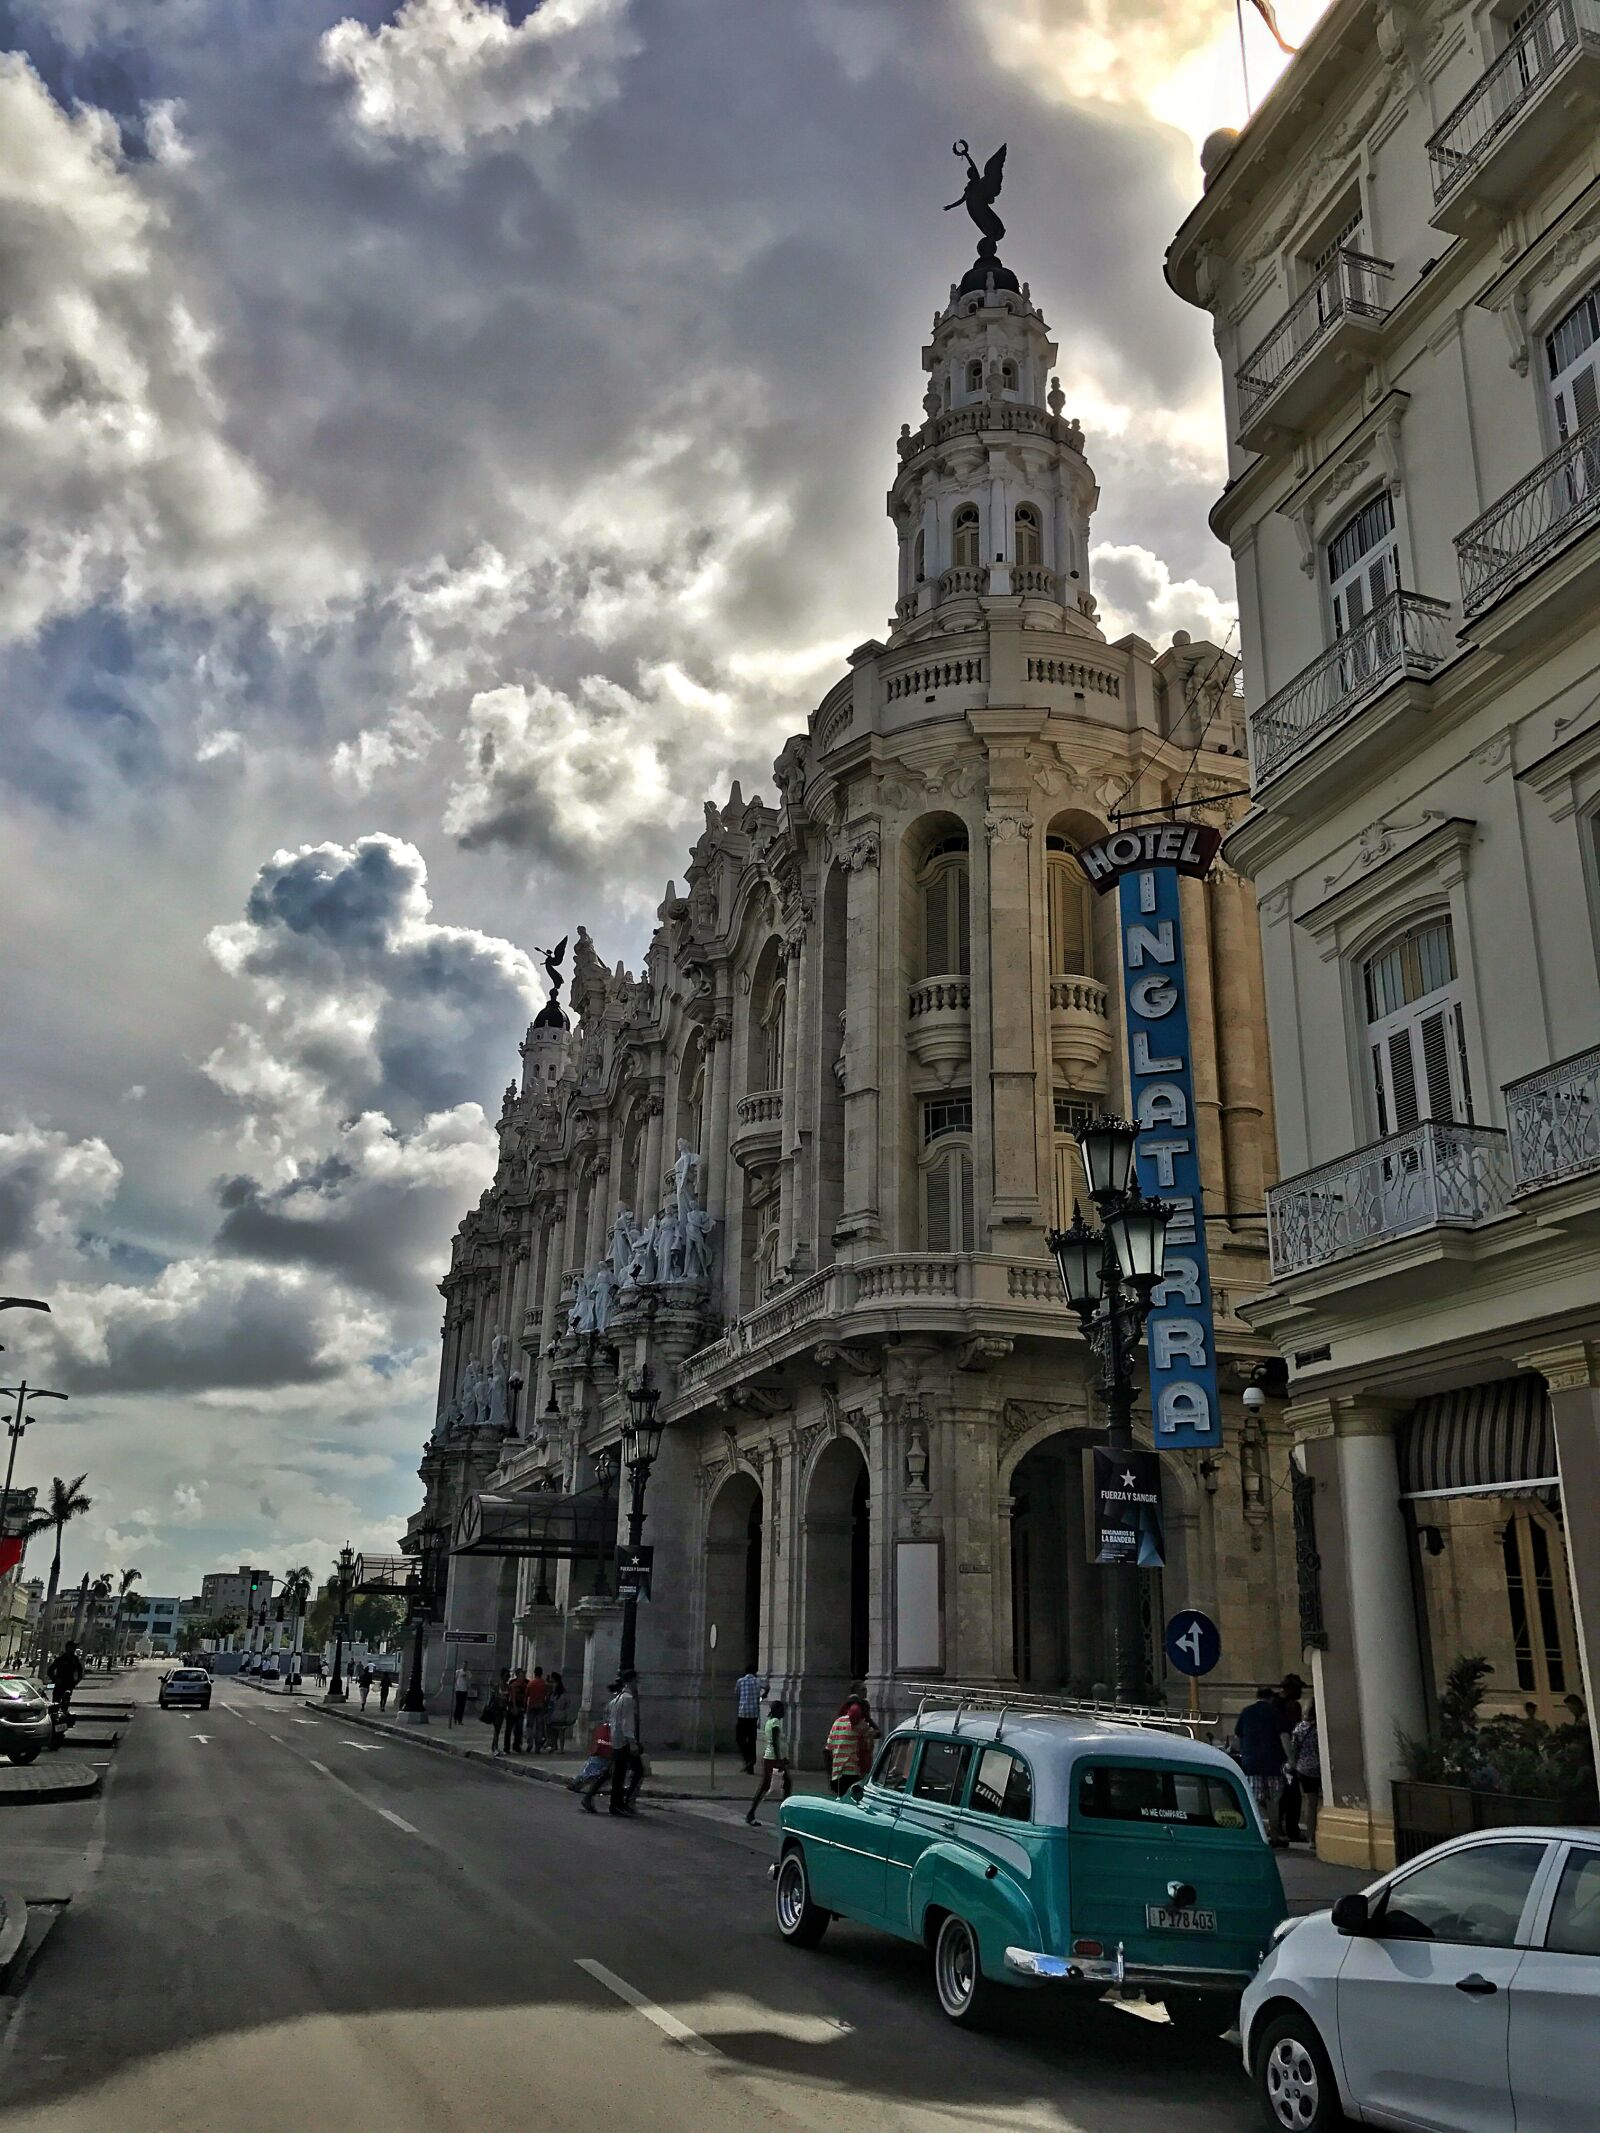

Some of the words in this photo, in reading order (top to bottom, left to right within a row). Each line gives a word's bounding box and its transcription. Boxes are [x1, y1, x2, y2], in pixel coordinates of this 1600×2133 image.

[1081, 825, 1200, 880] HOTEL
[1126, 871, 1211, 1433] INGLATERRA
[1101, 1490, 1126, 1500] FUERZA
[1127, 1492, 1131, 1501] Y
[1132, 1493, 1157, 1503] SANGRE
[1109, 1536, 1136, 1544] BANDERA
[1159, 1910, 1166, 1926] P
[1192, 1910, 1213, 1929] 403
